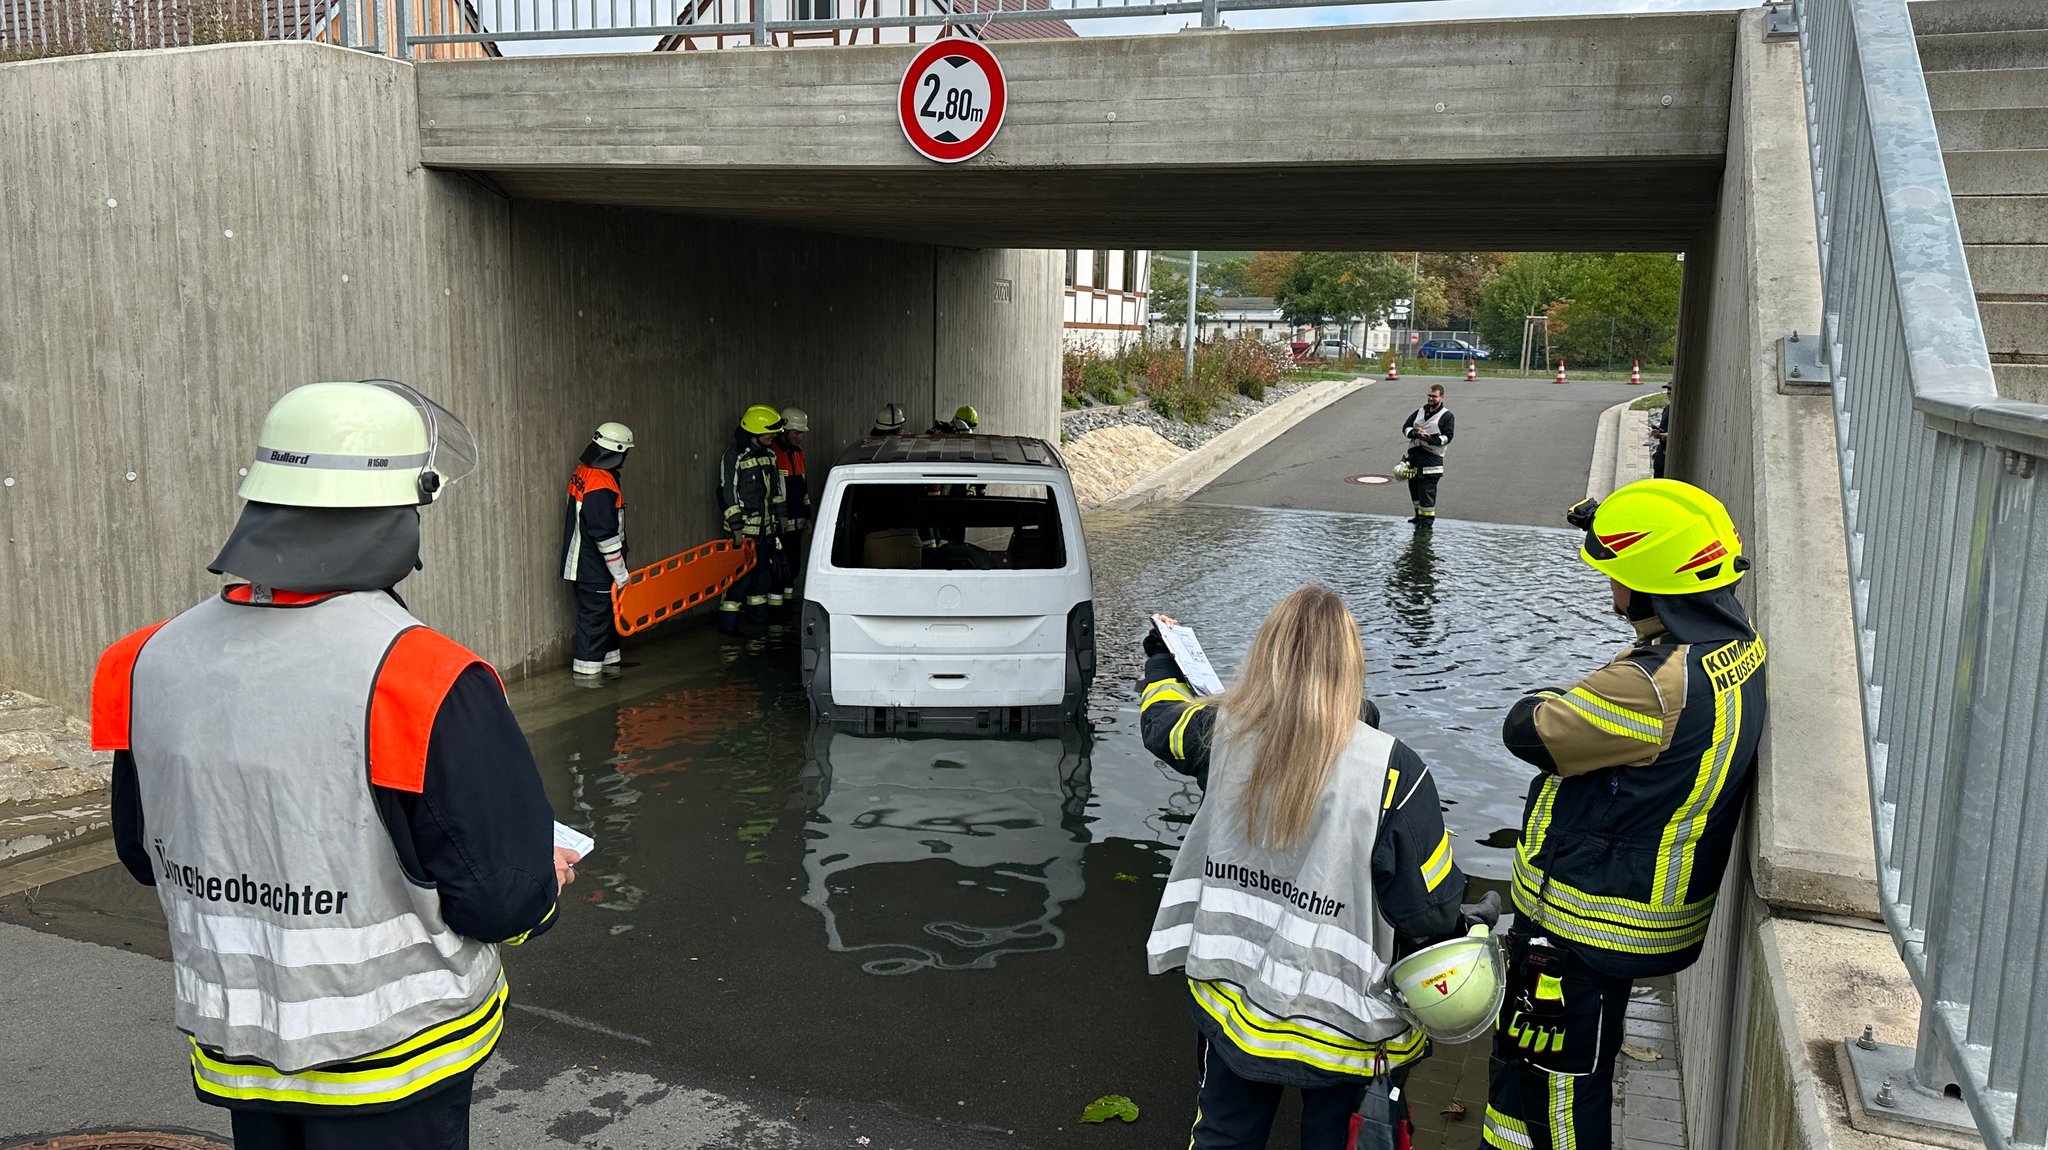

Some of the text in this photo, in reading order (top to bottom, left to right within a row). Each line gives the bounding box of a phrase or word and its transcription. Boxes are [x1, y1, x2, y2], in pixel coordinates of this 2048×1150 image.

[270, 450, 310, 465] Bullard
[1714, 652, 1756, 692] NEUSES
[1434, 980, 1448, 995] A
